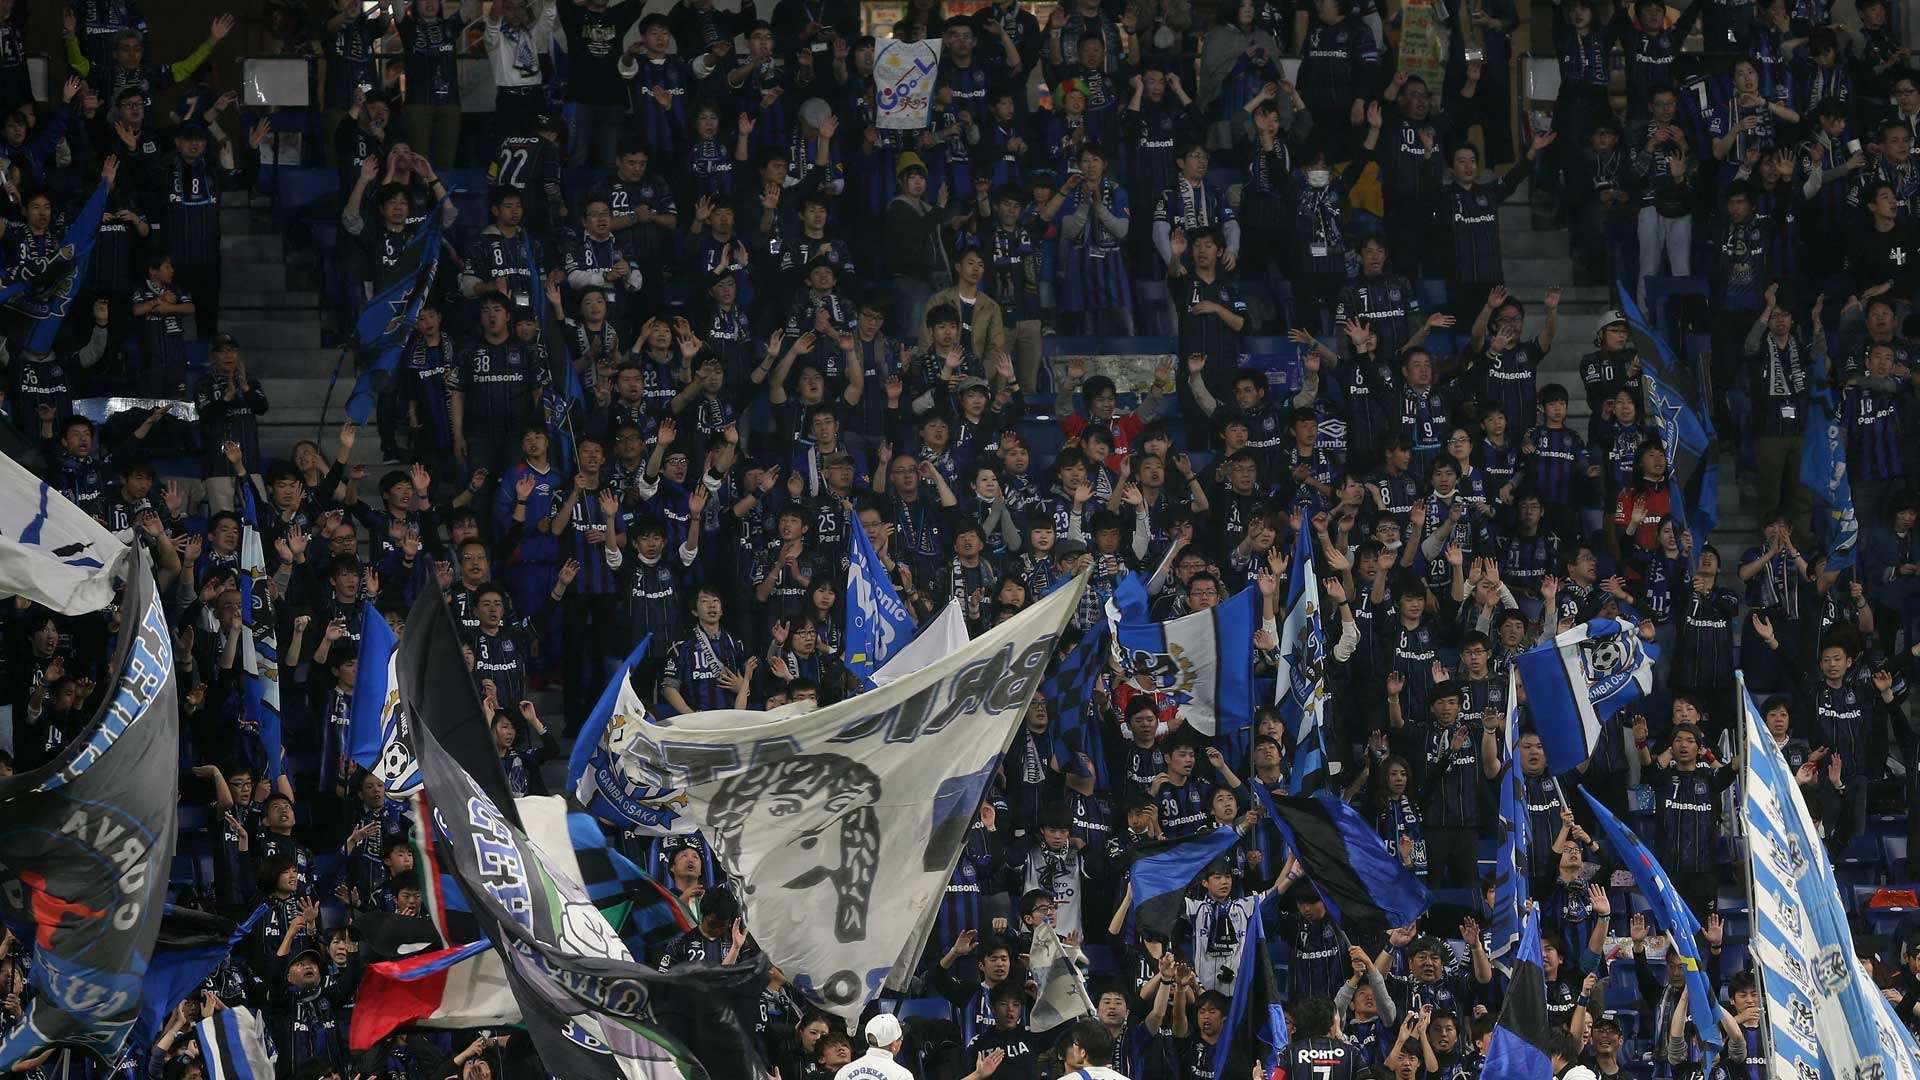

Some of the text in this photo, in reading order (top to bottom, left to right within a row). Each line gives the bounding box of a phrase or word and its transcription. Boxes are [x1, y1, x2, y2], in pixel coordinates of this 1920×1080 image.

[184, 96, 199, 121] 7
[498, 148, 528, 189] 22
[193, 178, 200, 194] 8
[612, 191, 629, 208] 22
[494, 249, 503, 265] 8
[585, 250, 593, 266] 8
[801, 251, 808, 264] 7
[1360, 295, 1368, 312] 7
[474, 356, 490, 373] 38
[473, 373, 524, 383] Panasonic
[643, 371, 657, 387] 22
[1356, 367, 1363, 385] 6
[1489, 369, 1532, 380] Panasonic
[22, 384, 67, 394] Panasonic
[642, 389, 677, 398] Panaso
[1424, 422, 1434, 438] 9
[1246, 438, 1280, 448] nasonic
[1380, 487, 1391, 505] 8
[114, 511, 128, 529] 10
[572, 522, 608, 532] Panason
[818, 513, 836, 533] 25
[1053, 511, 1069, 530] 23
[1430, 559, 1446, 576] 29
[632, 586, 674, 599] Panasoni
[459, 600, 466, 617] 7
[1361, 593, 1369, 610] 7
[1561, 600, 1579, 618] 39
[1652, 595, 1664, 611] 11
[1692, 599, 1700, 617] 7
[1686, 616, 1727, 629] Panasonic
[476, 660, 518, 672] Panasoni
[48, 725, 62, 744] 14
[1127, 770, 1155, 784] Panaso
[598, 769, 658, 824] GAMBA OSAKA
[1672, 782, 1680, 800] 7
[1162, 798, 1179, 817] 39
[1527, 798, 1561, 812] nasonic
[1665, 799, 1712, 812] Panasonic
[1073, 817, 1112, 832] Panason
[1162, 811, 1208, 827] Panasonic
[760, 1004, 768, 1022] 8
[1298, 1048, 1345, 1064] ROHTO
